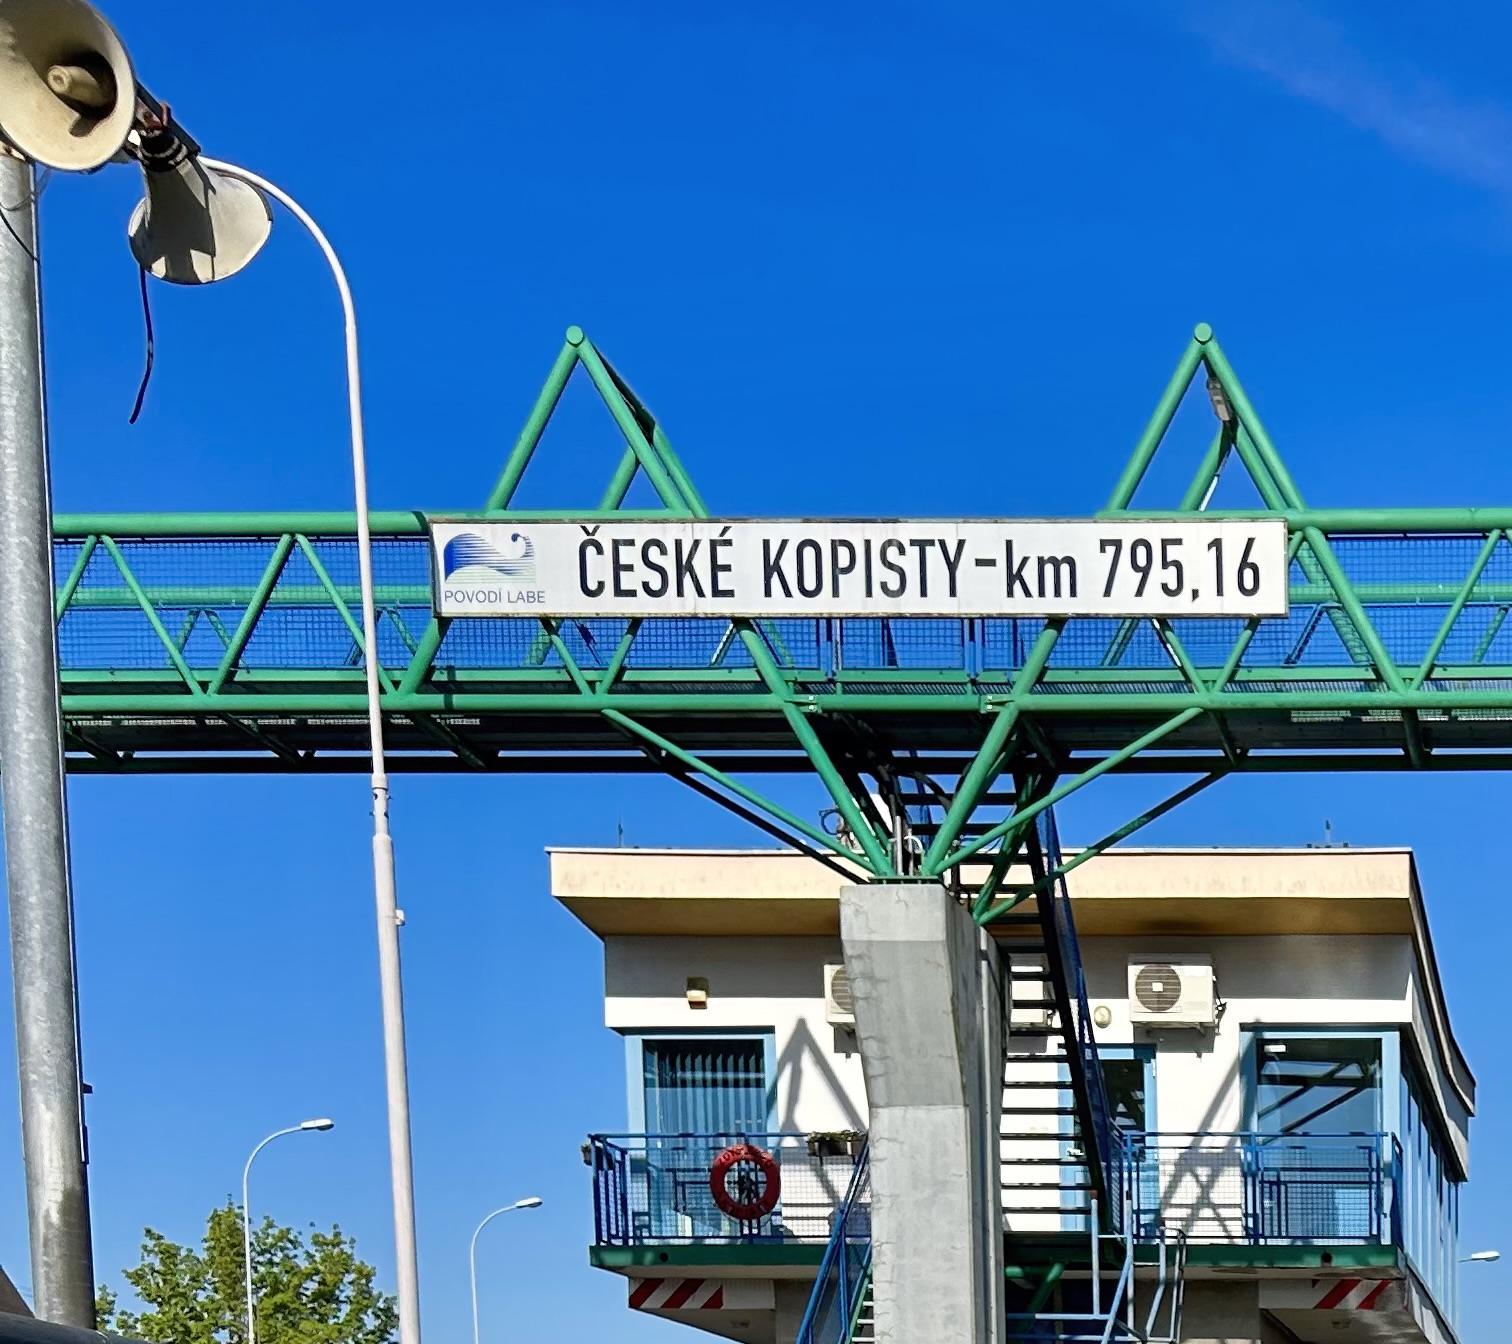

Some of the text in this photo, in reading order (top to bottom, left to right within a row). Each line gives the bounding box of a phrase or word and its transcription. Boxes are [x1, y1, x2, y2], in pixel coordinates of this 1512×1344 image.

[578, 525, 735, 599] ČESKÉ
[1099, 537, 1261, 602] 795,16
[444, 588, 546, 604] POVODÍ LABE
